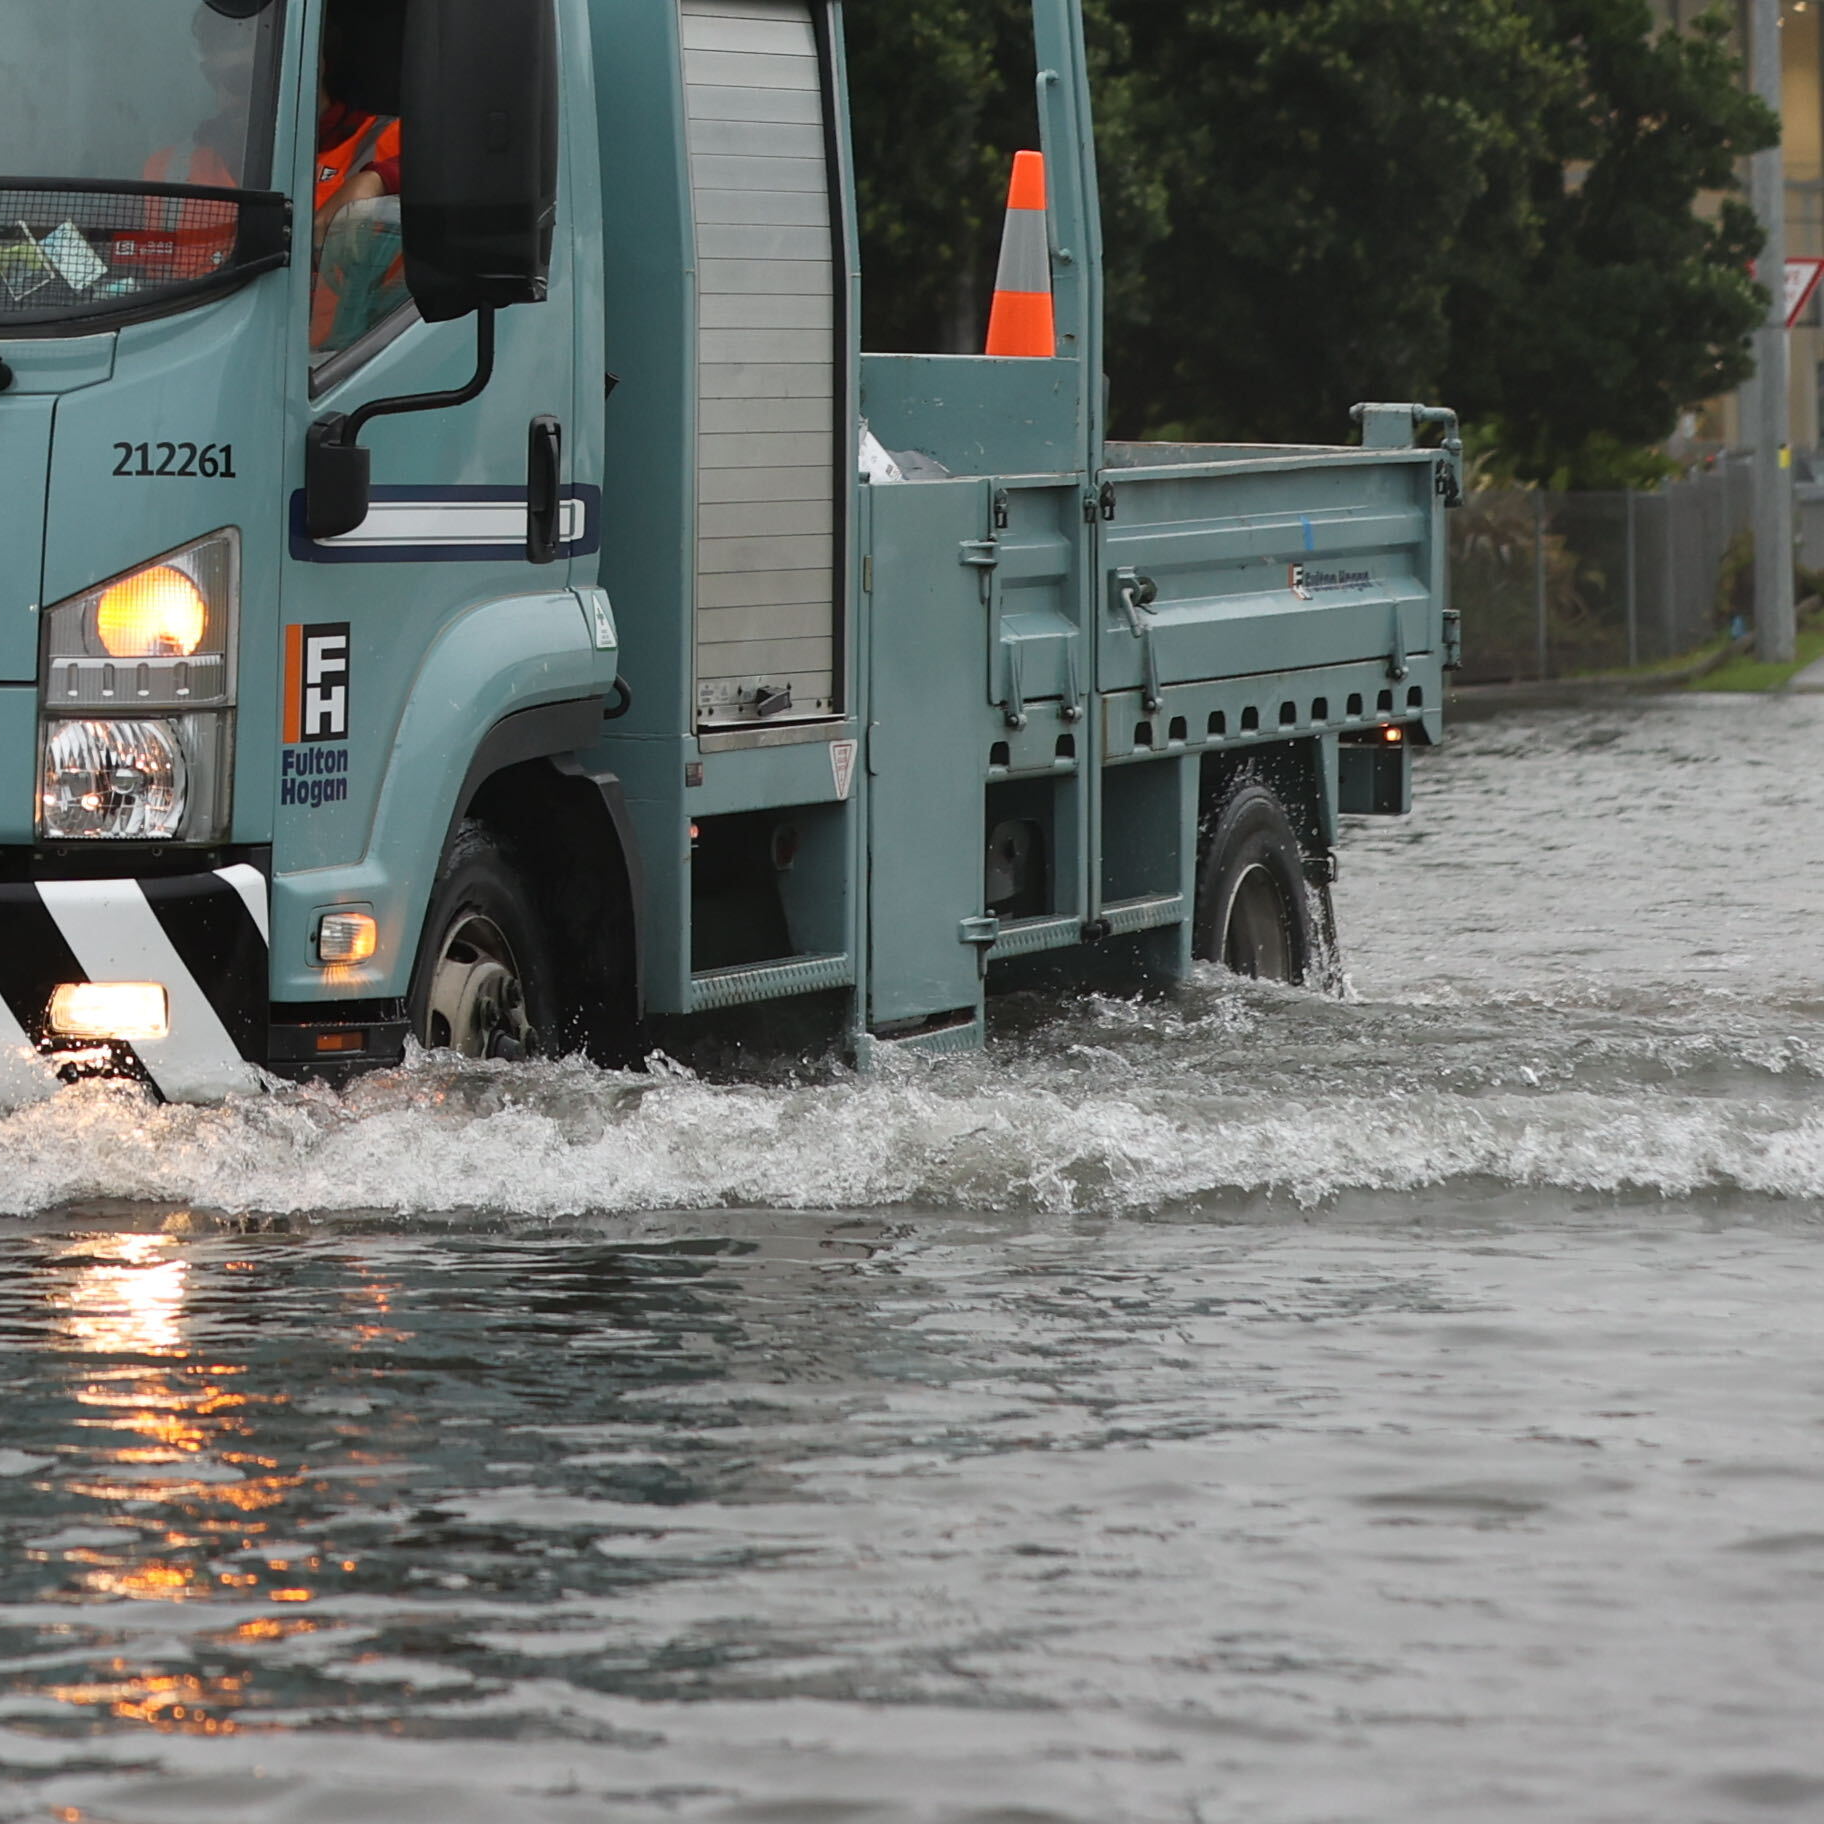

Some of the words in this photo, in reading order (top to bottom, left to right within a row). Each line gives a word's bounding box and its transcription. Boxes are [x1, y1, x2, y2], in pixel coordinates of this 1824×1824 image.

[112, 442, 237, 479] 212261
[282, 747, 348, 776] Fulton
[281, 777, 348, 809] Hogan
